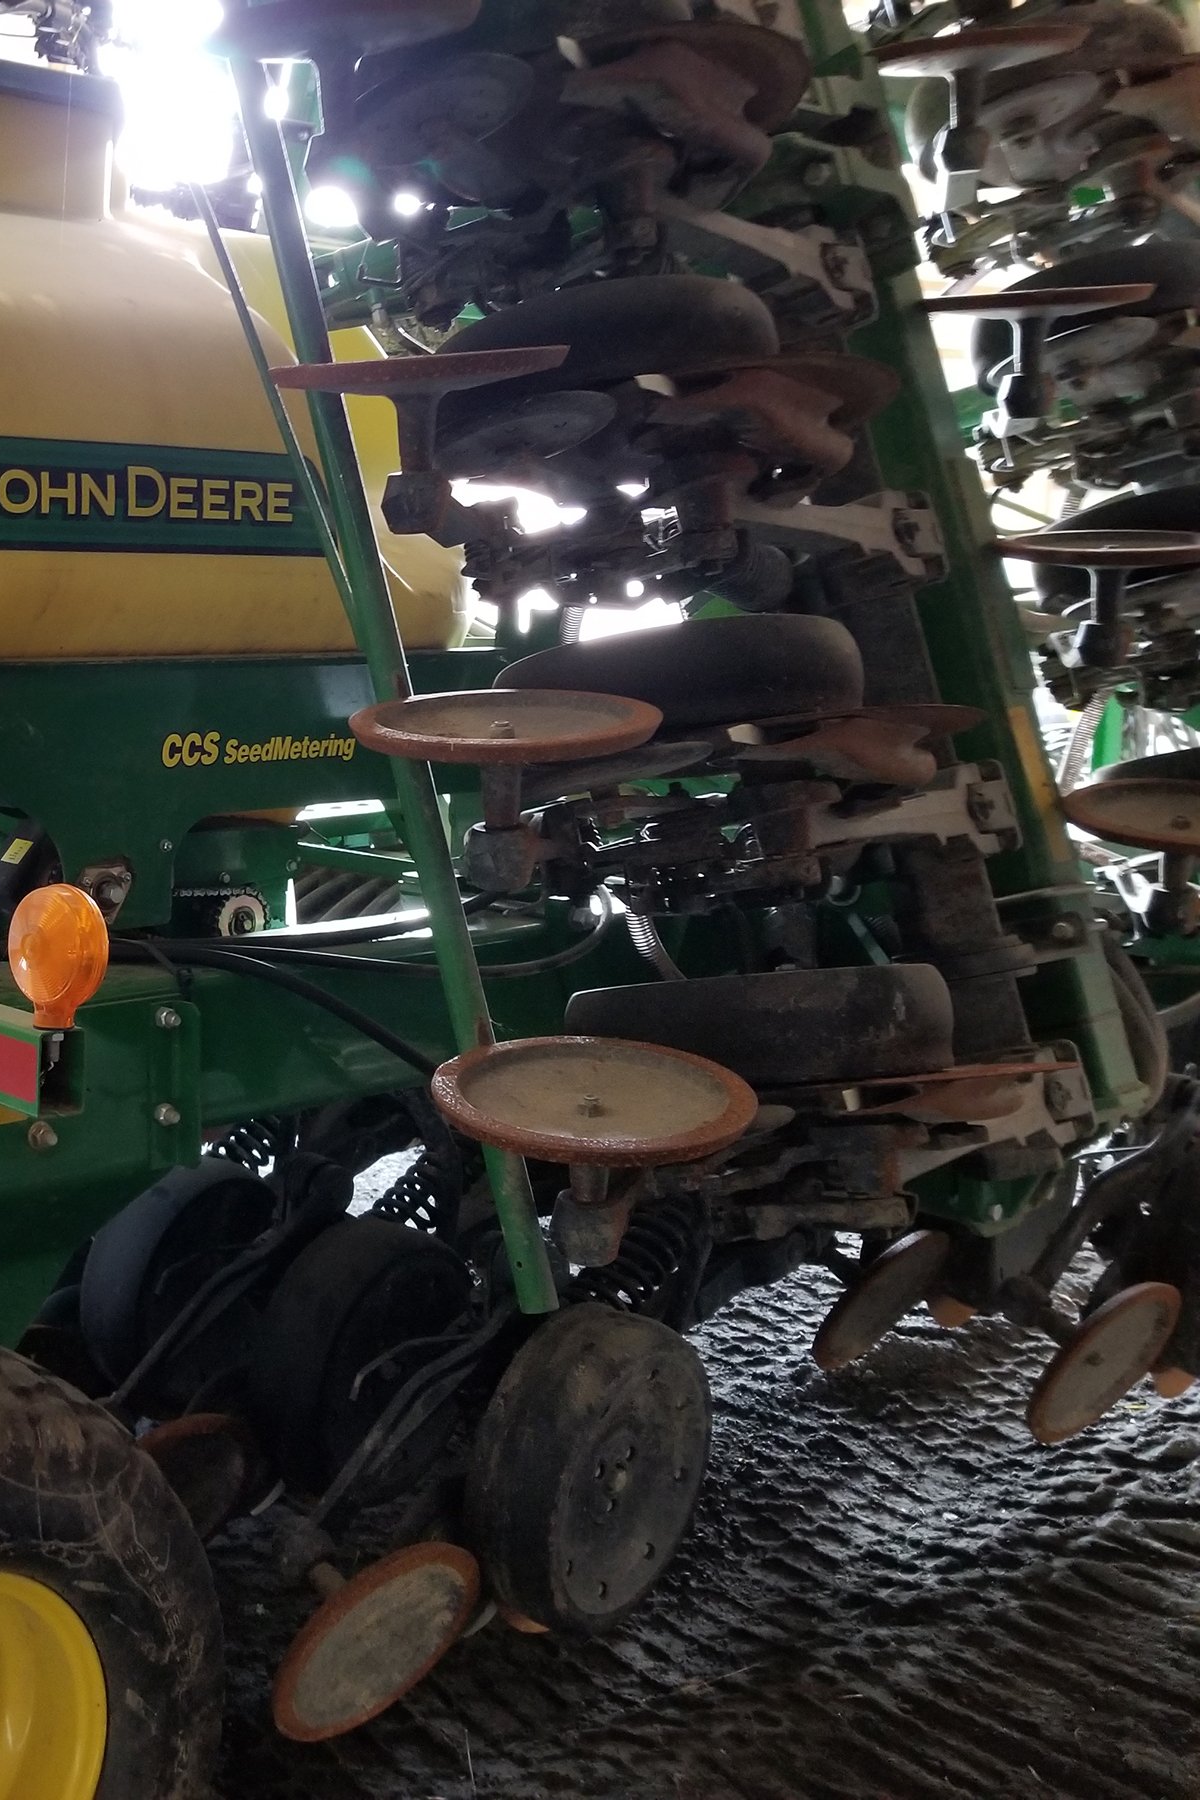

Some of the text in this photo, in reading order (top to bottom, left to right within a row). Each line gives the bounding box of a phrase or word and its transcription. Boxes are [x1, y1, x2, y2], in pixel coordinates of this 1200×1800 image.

[127, 466, 294, 523] DEERE
[162, 732, 356, 768] CCS SeedMetering
